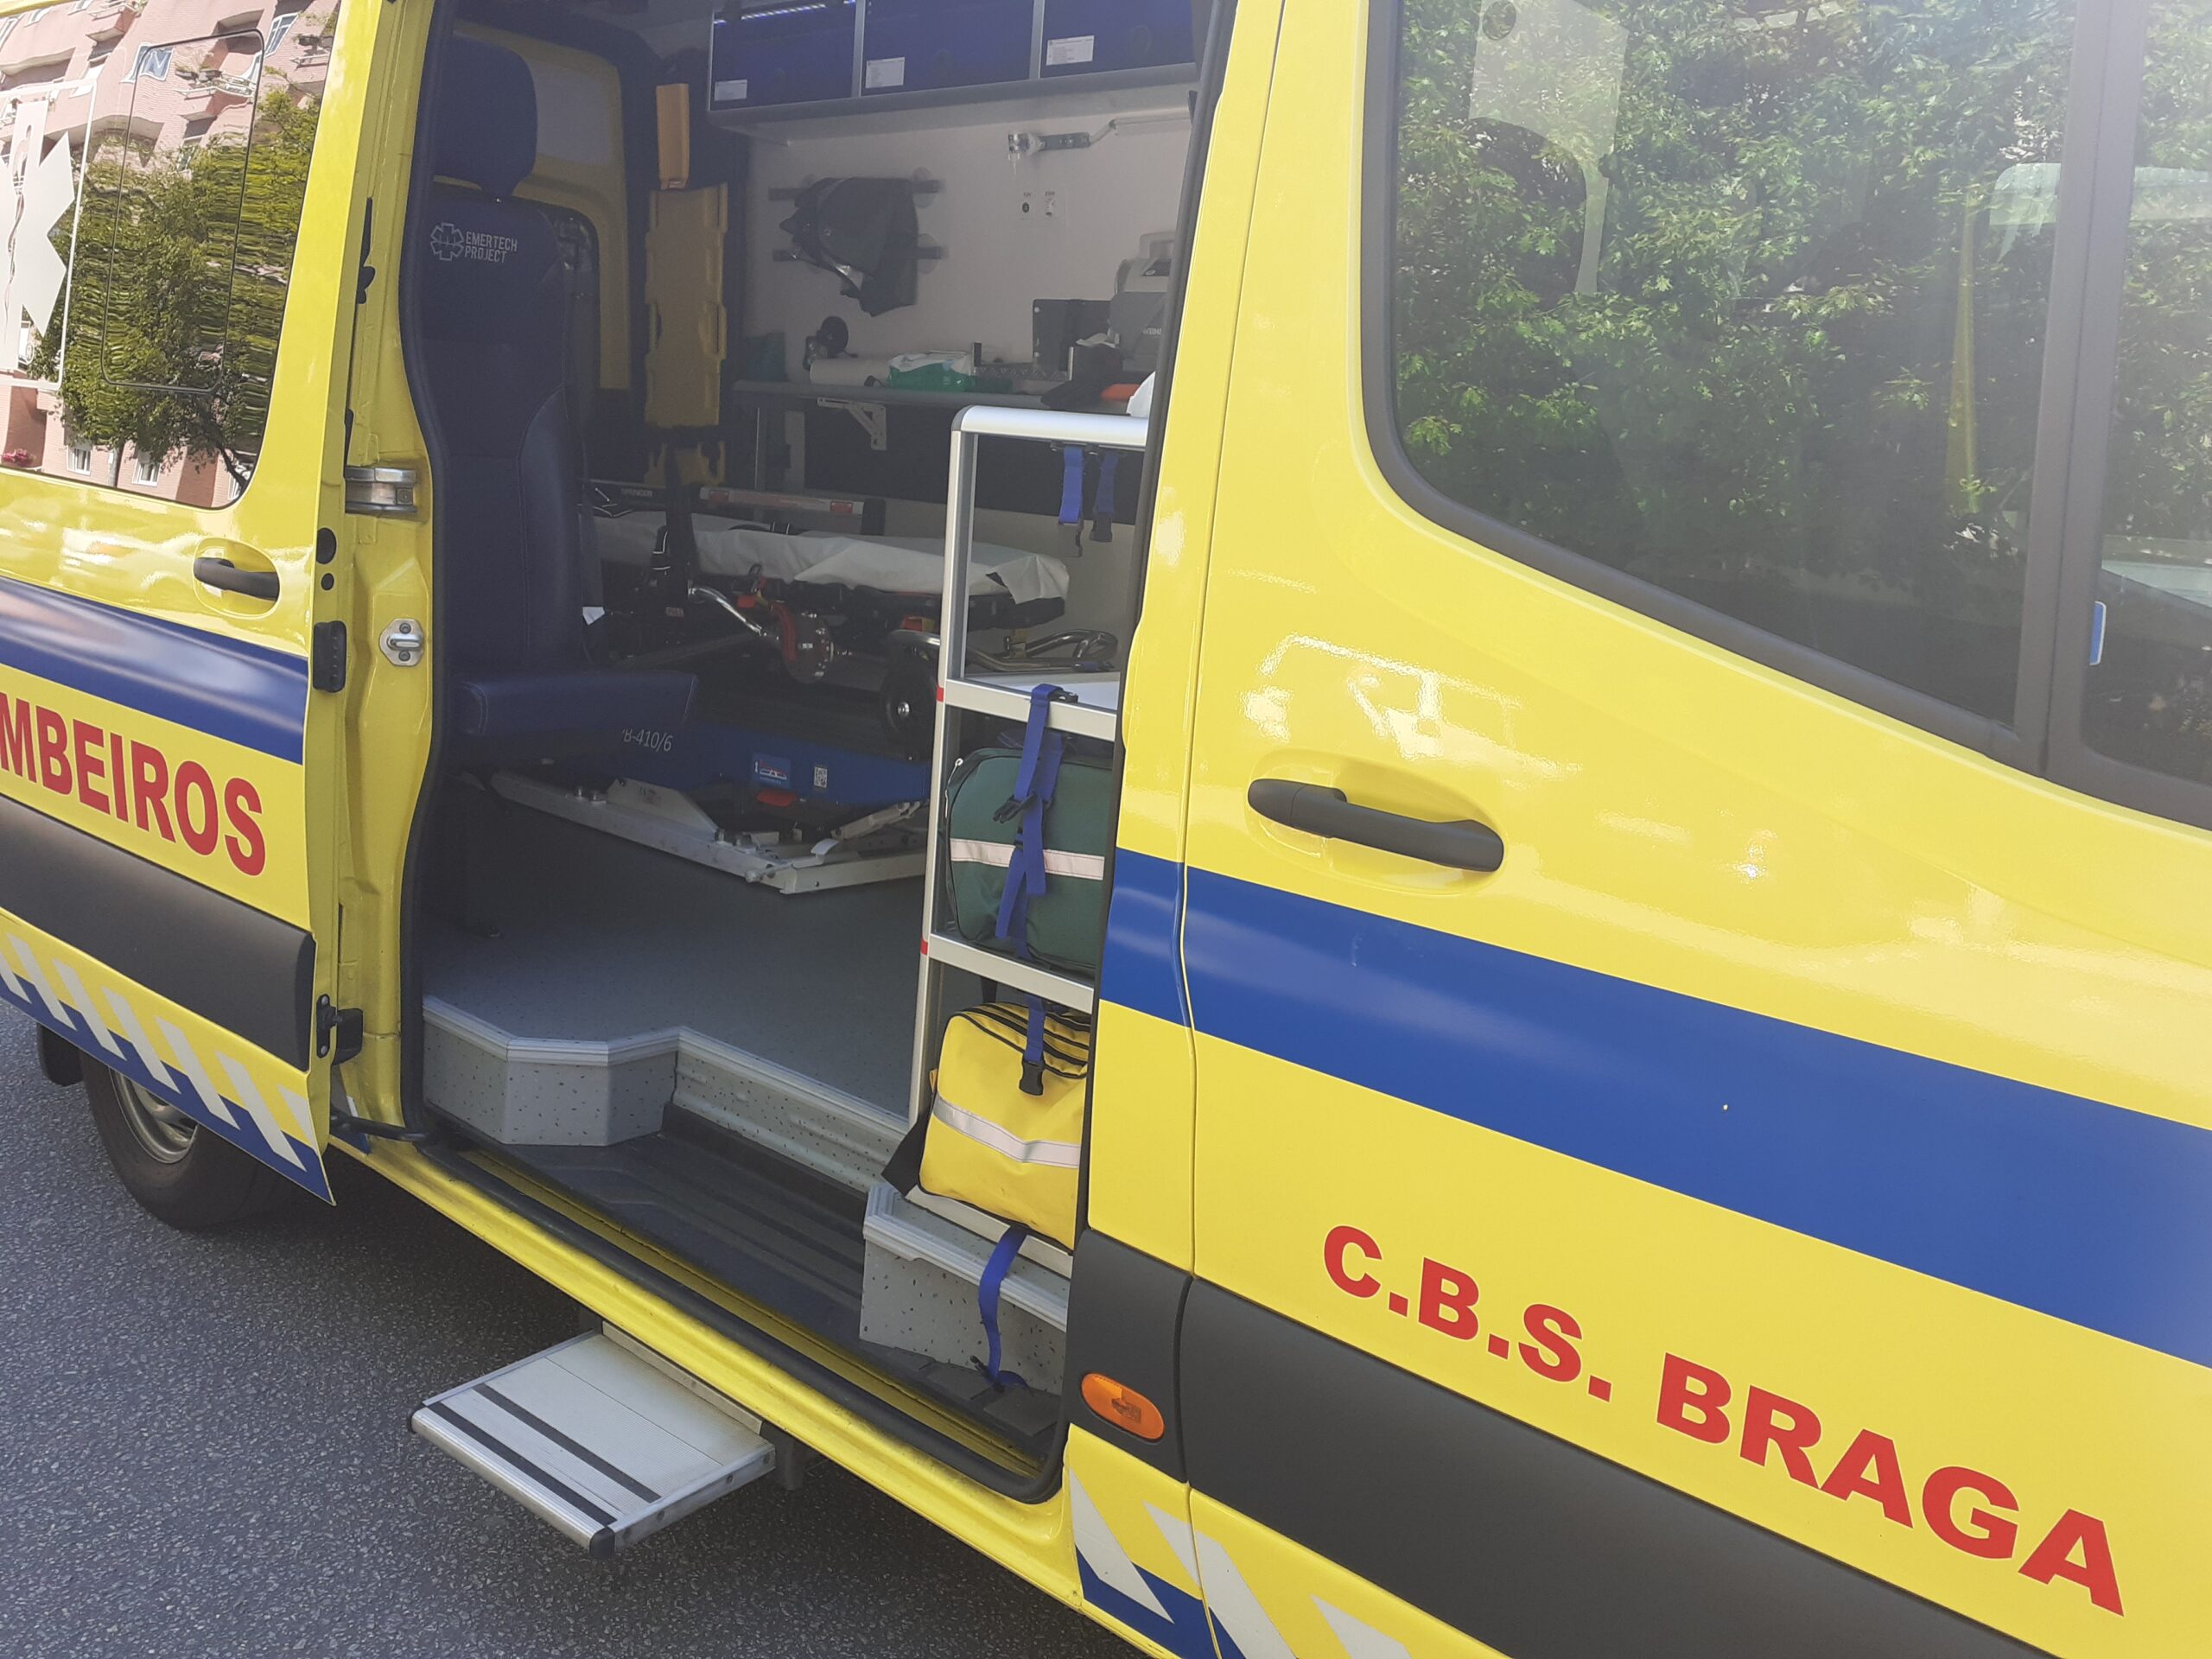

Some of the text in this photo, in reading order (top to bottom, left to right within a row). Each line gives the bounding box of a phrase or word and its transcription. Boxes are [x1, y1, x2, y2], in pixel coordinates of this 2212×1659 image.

[464, 245, 507, 264] PROJECT
[466, 231, 518, 252] EMERTECH
[0, 690, 266, 877] MBEIROS
[1323, 1225, 2125, 1618] C.B.S. BRAGA
